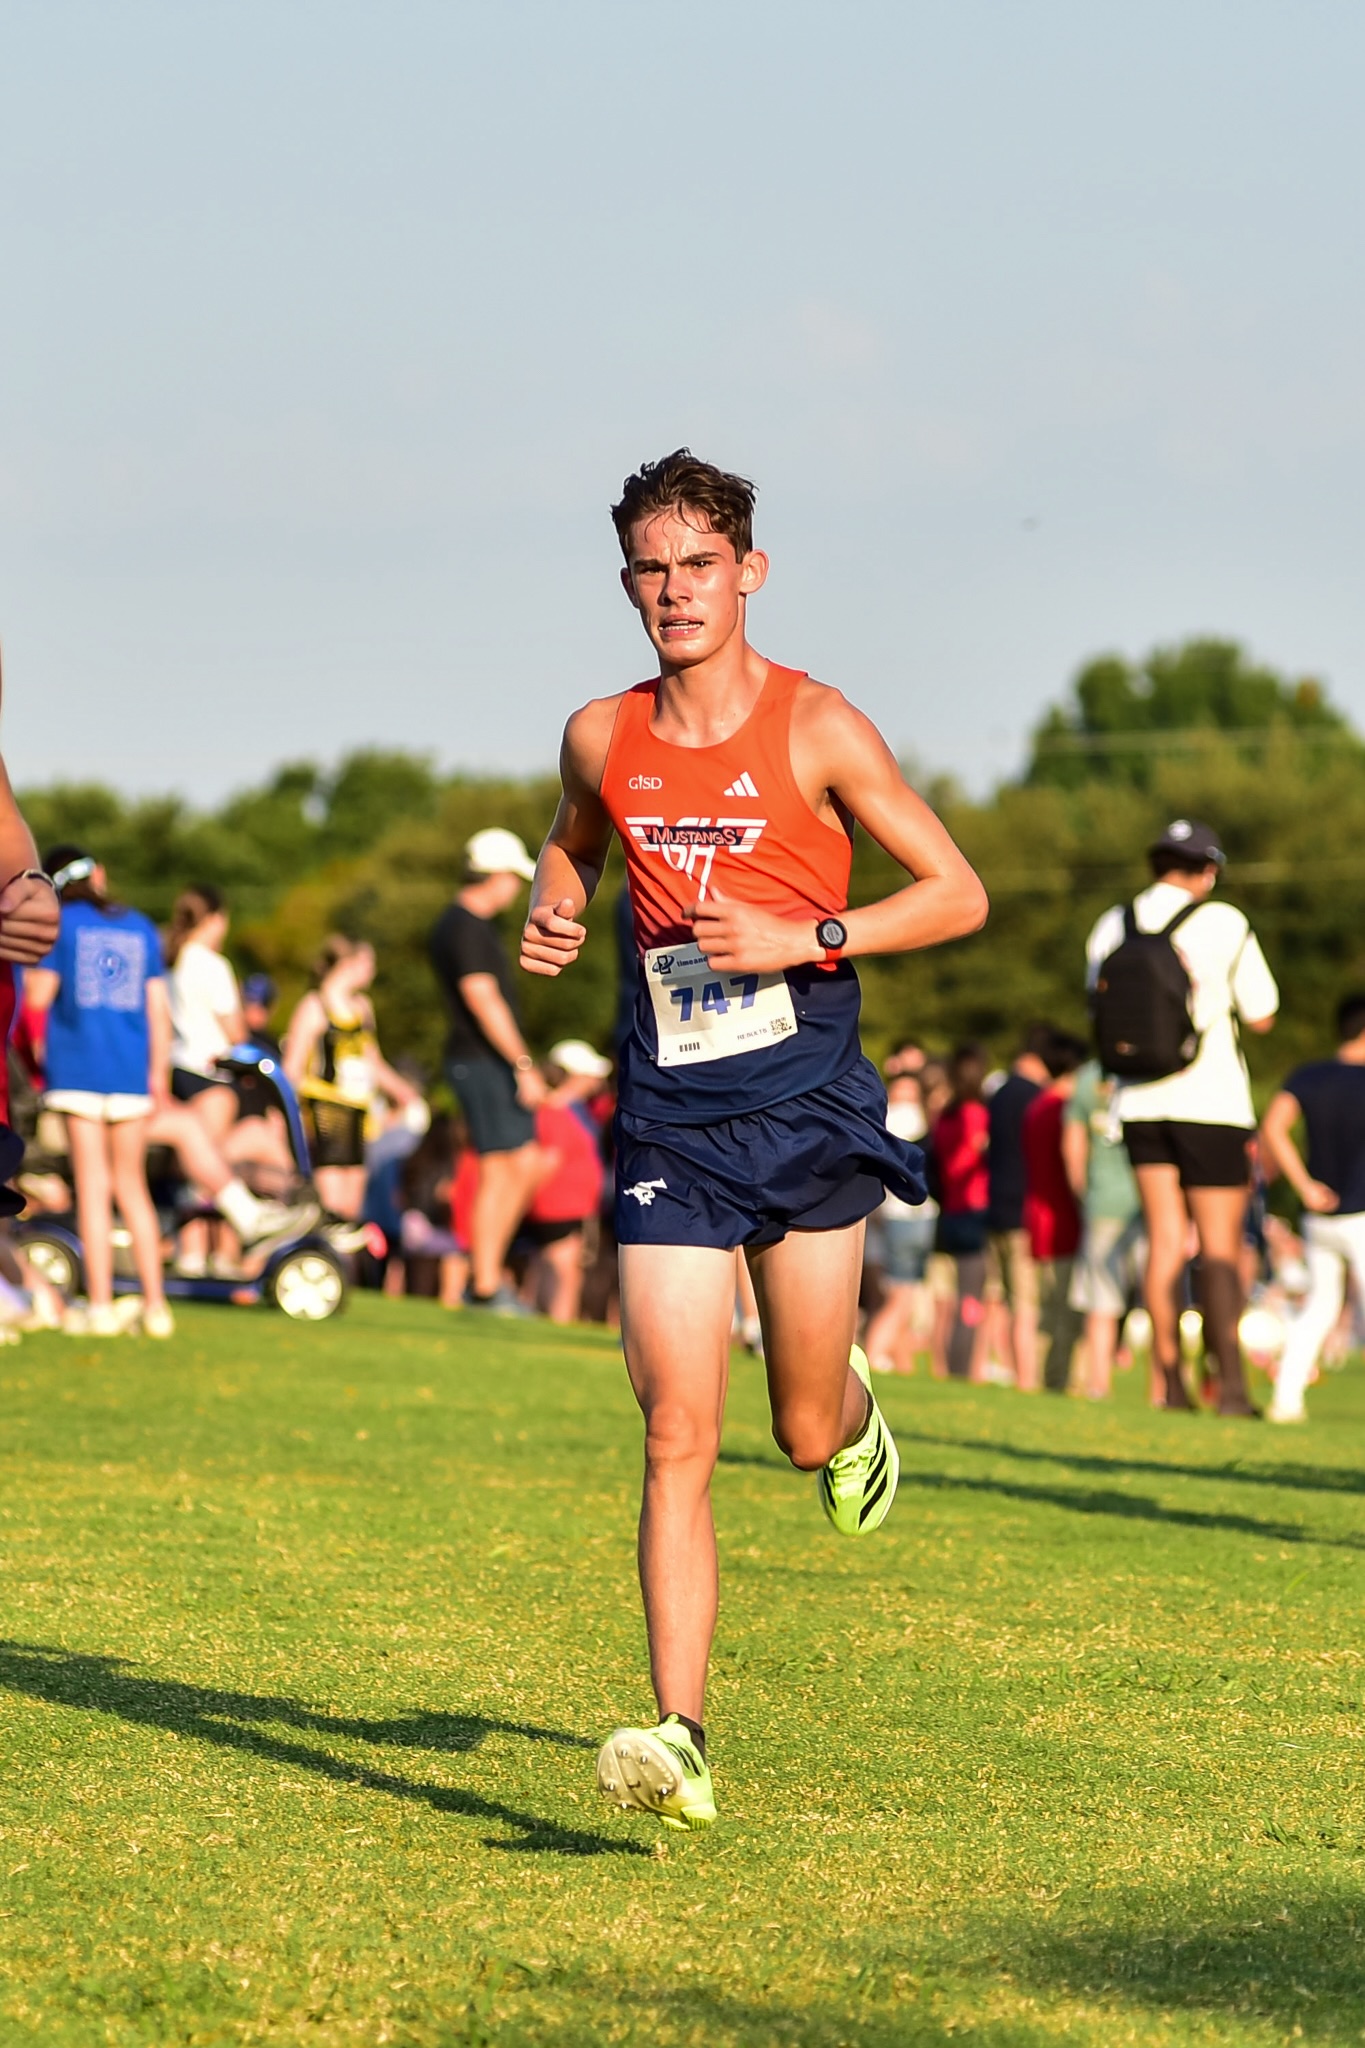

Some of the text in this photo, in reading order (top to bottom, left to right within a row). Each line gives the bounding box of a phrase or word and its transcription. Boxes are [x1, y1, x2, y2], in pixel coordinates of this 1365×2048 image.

[628, 774, 663, 790] GISD
[651, 826, 737, 845] MUSTANGS
[670, 973, 759, 1022] 747
